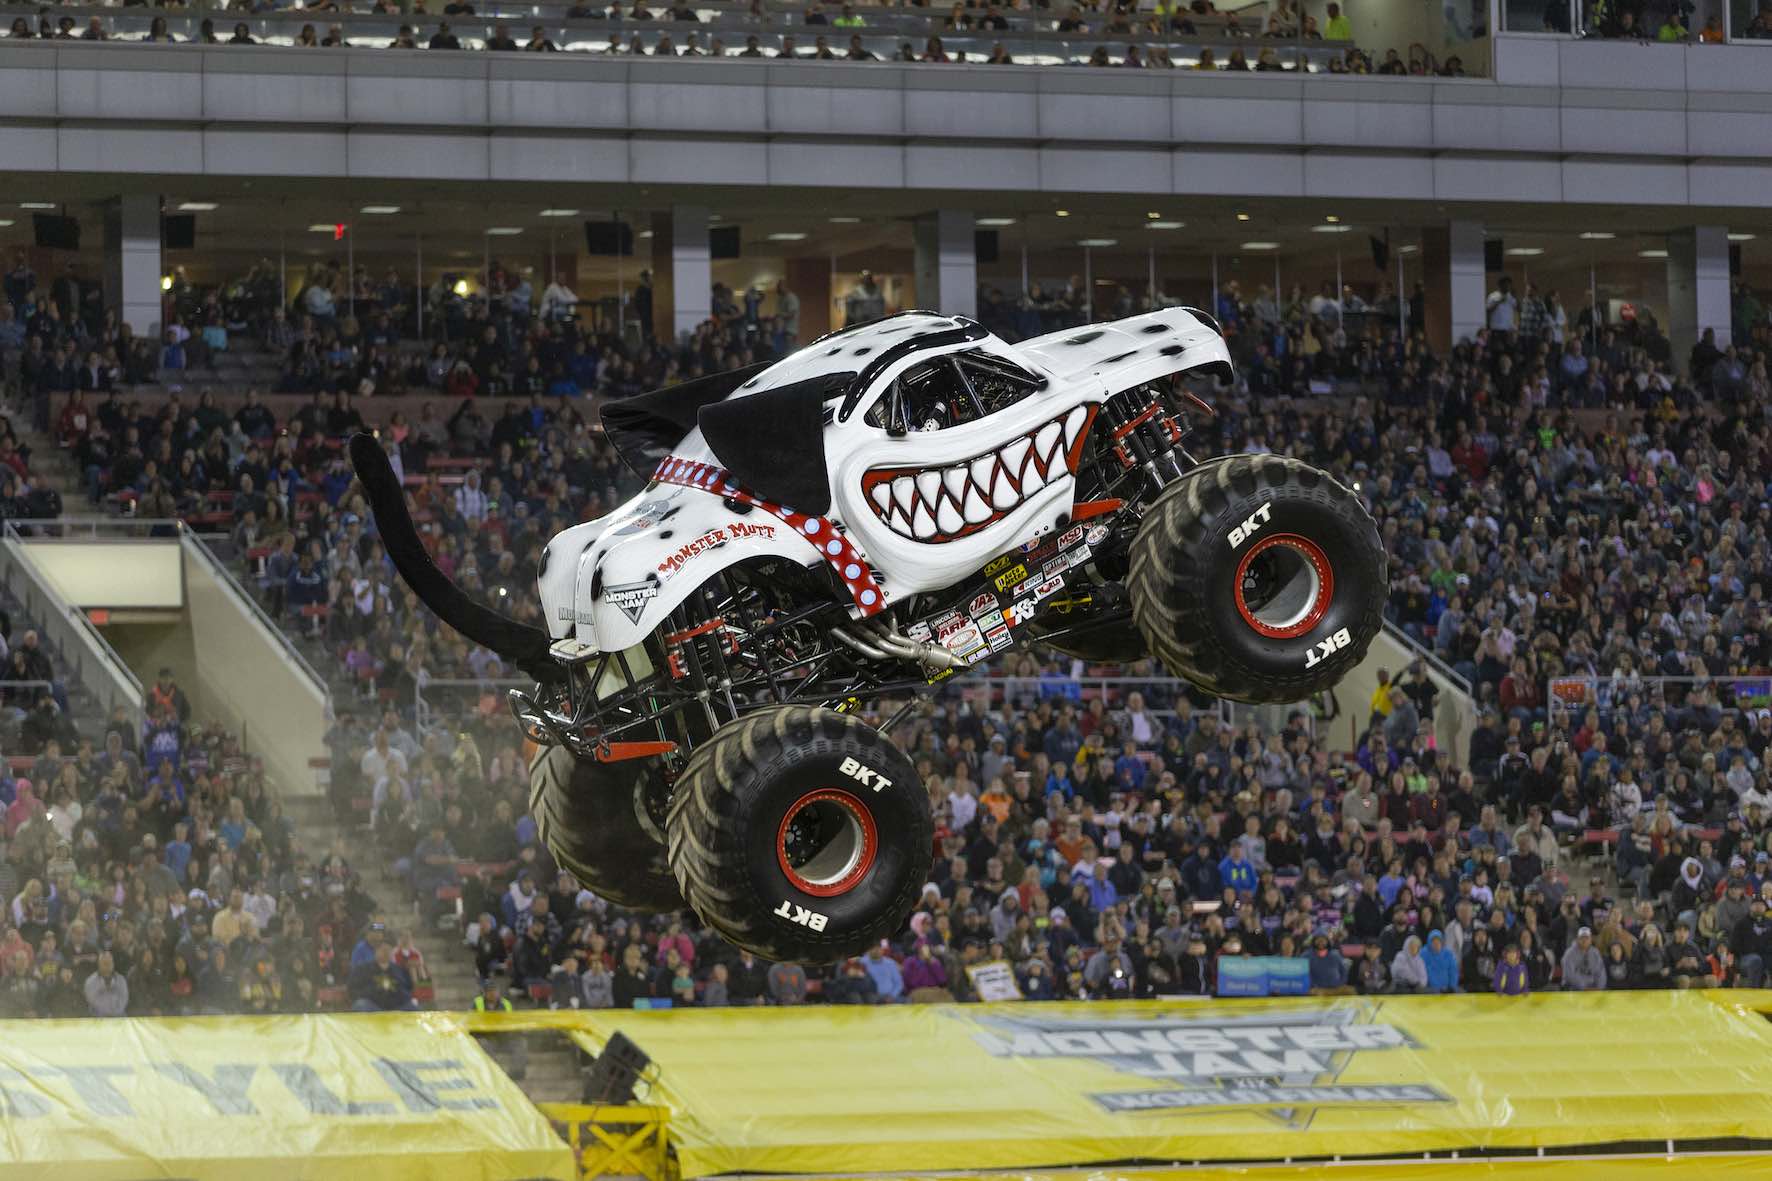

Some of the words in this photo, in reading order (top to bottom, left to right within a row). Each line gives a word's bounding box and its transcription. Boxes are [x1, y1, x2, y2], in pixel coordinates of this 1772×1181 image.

[1058, 527, 1083, 547] MSD
[1226, 502, 1272, 549] BKT
[657, 530, 729, 576] MONSTER
[727, 521, 776, 544] MUTT
[605, 586, 657, 605] MONSTER
[621, 598, 645, 609] JAM
[931, 611, 956, 630] LINCOLN
[939, 617, 970, 641] ARP
[988, 631, 1010, 645] Holley
[1305, 627, 1351, 668] BKT
[839, 757, 892, 793] BKT
[774, 900, 828, 932] BKT
[973, 1025, 1410, 1058] MONSTER
[1132, 1050, 1327, 1075] JAM
[1109, 1090, 1265, 1109] WORLD
